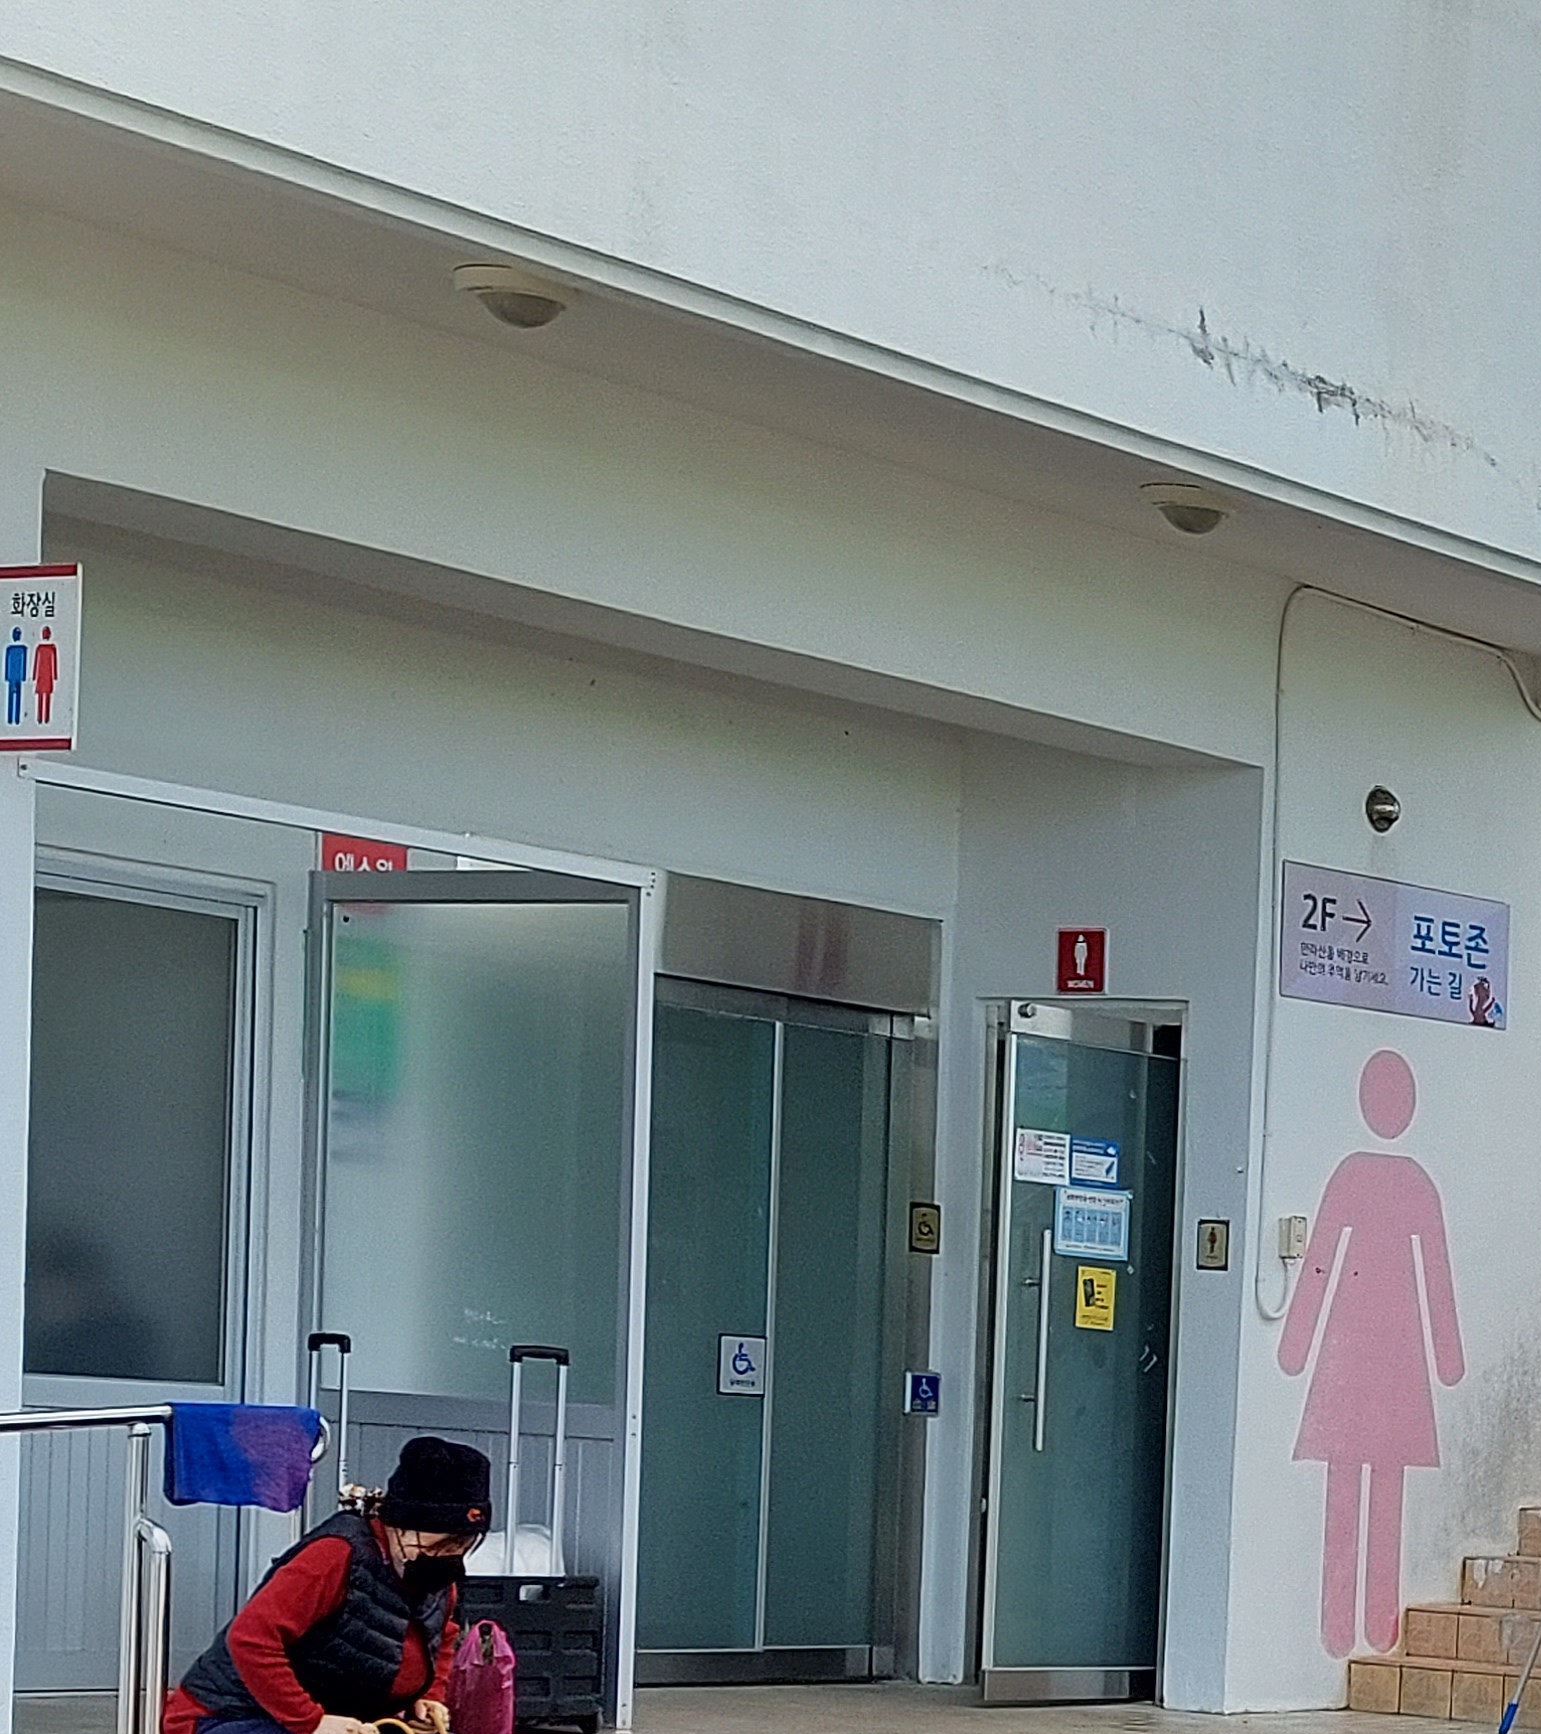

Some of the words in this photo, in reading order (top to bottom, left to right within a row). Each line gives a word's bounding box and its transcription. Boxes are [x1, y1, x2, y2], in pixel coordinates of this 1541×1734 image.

[11, 591, 56, 617] 화장실
[1301, 893, 1337, 932] 2F
[1410, 914, 1490, 970] 포토존
[1410, 966, 1442, 996] 가는
[1448, 971, 1463, 1001] 길
